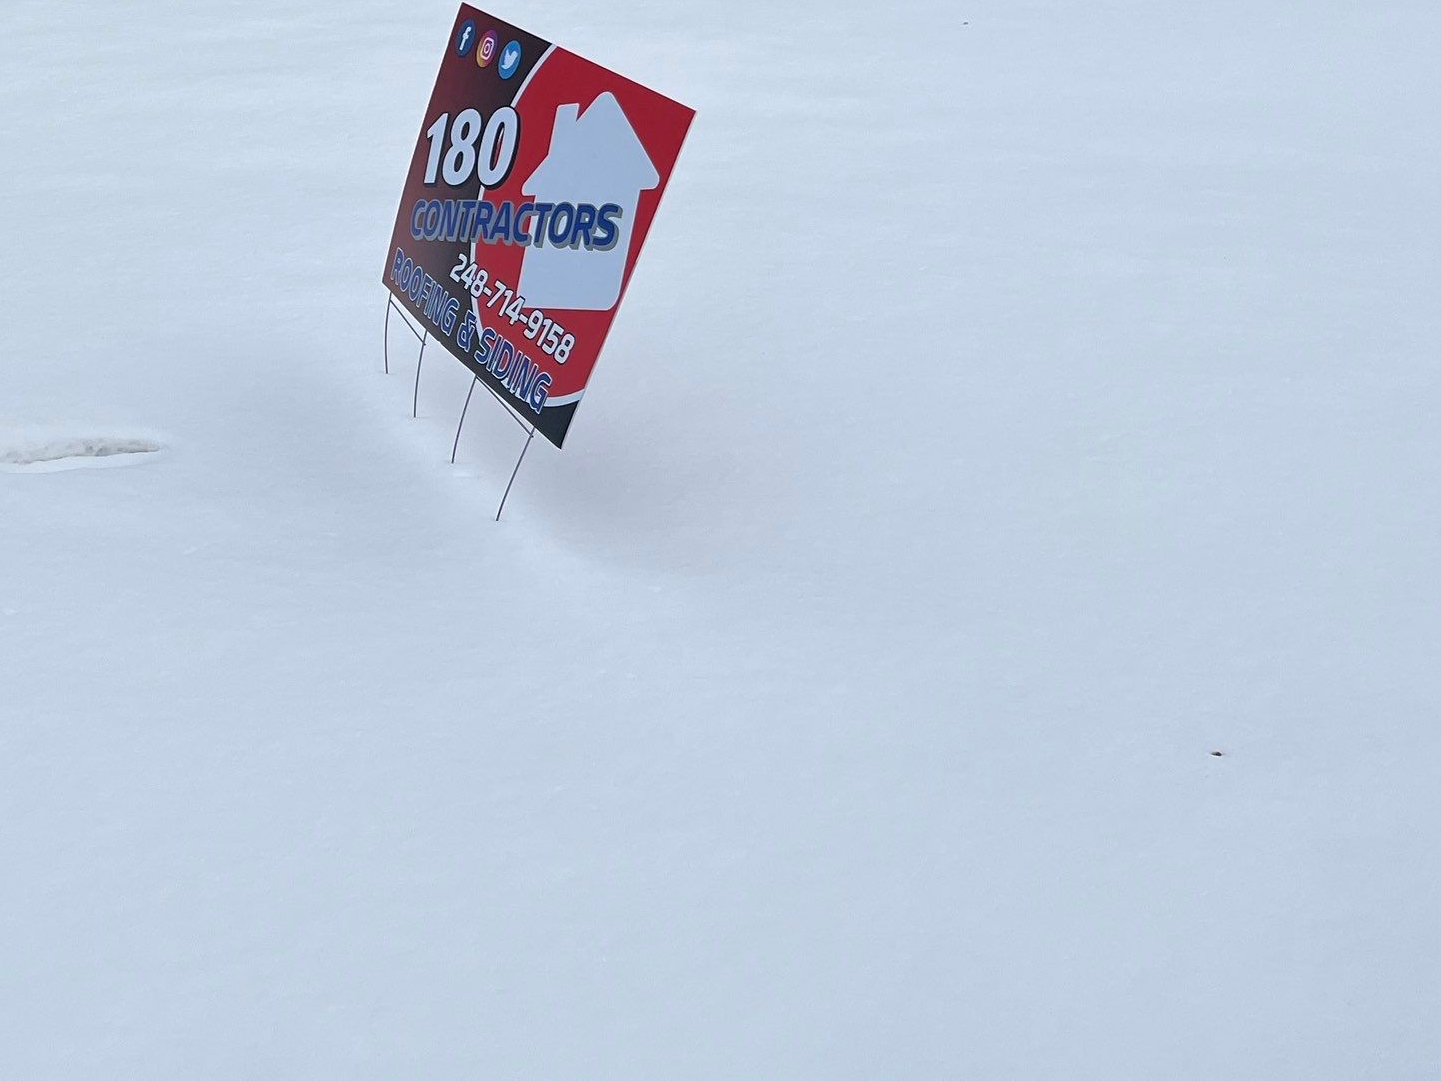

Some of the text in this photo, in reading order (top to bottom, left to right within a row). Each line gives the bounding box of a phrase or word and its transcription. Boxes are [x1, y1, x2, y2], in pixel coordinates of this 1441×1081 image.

[423, 106, 520, 188] 180
[410, 199, 623, 252] CONTRACTORS
[390, 247, 553, 415] ROOFING & SIDING
[449, 253, 575, 365] 248-714-9158
